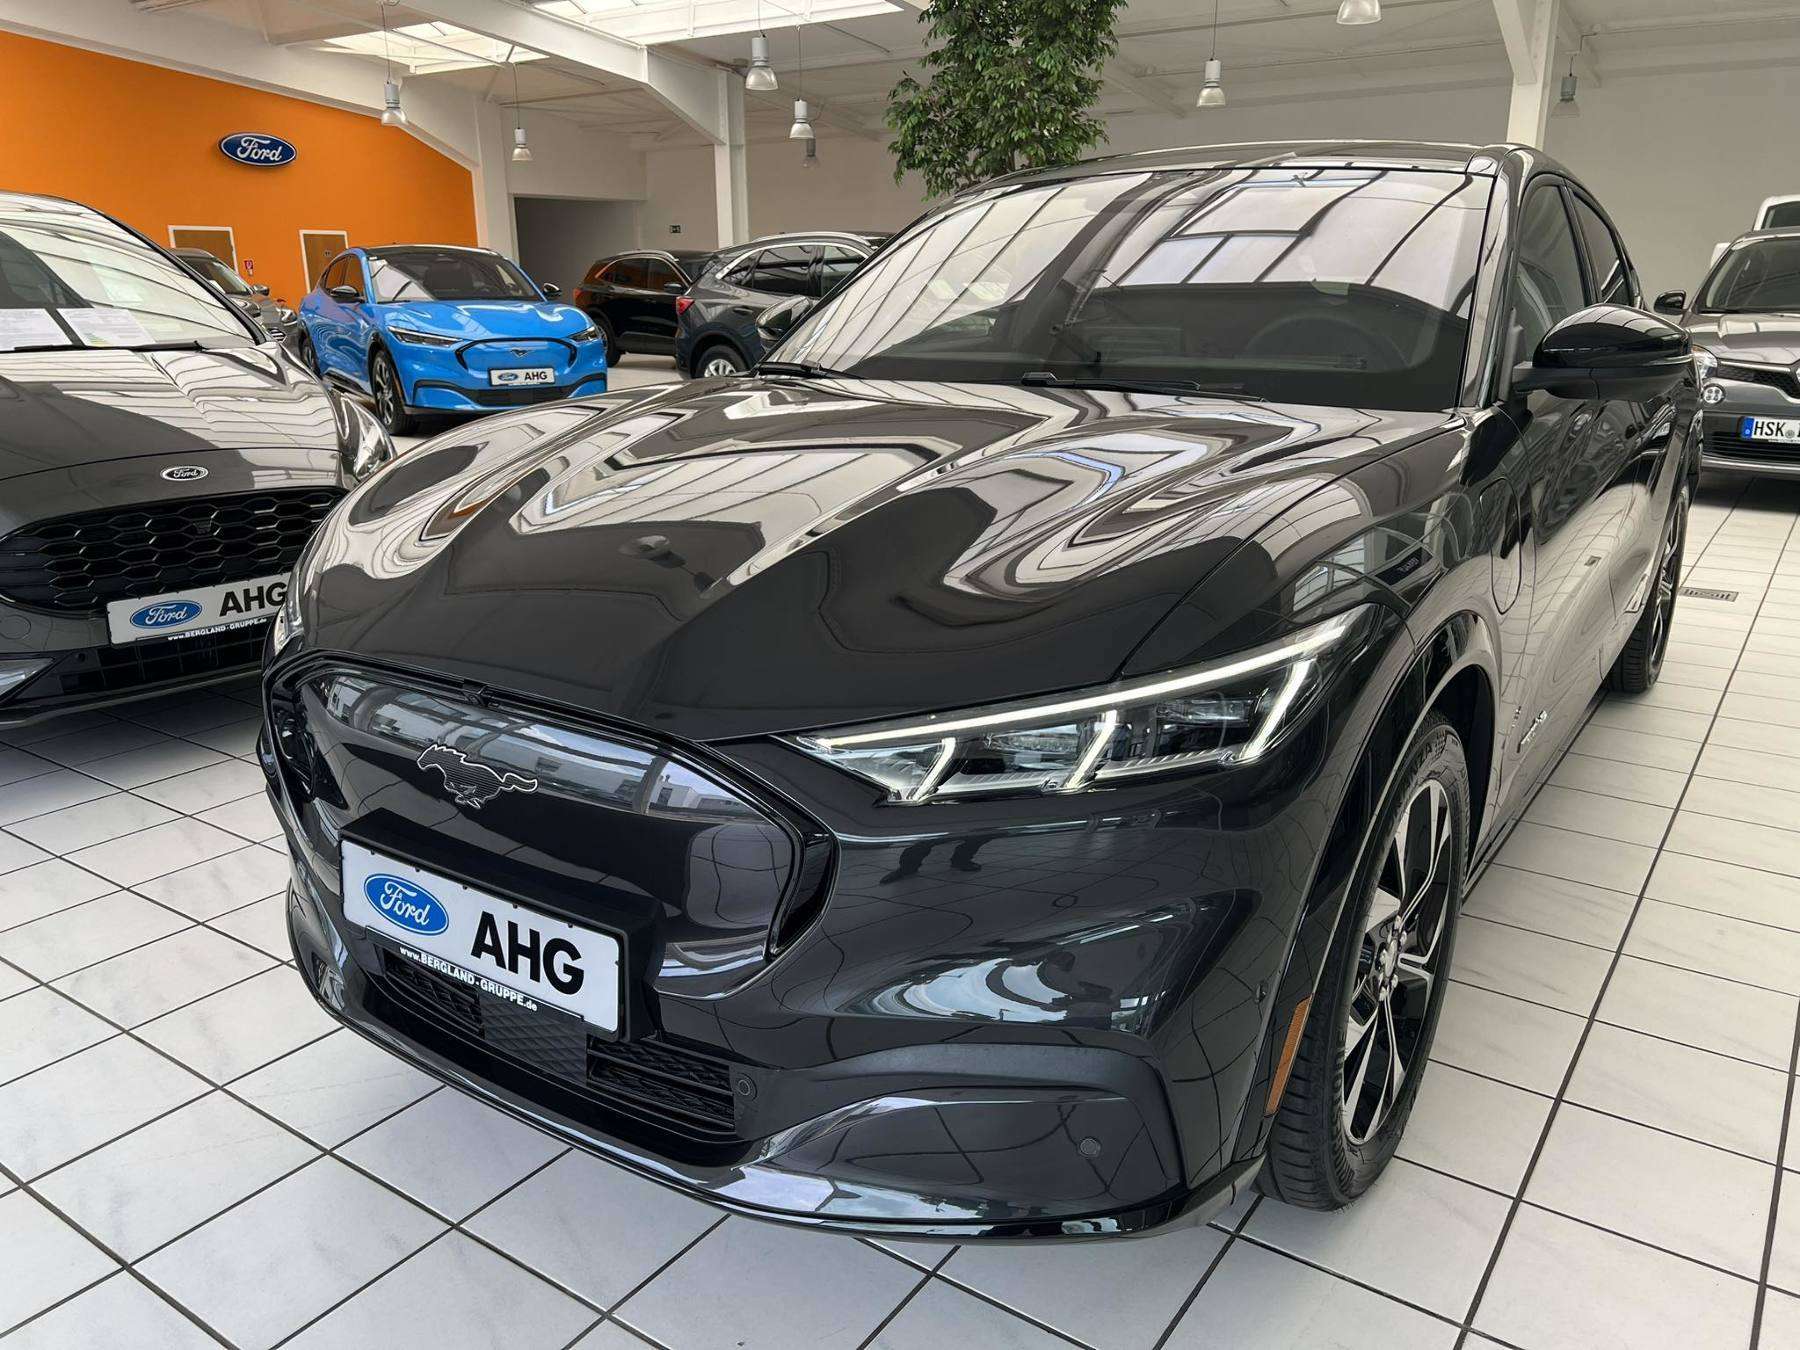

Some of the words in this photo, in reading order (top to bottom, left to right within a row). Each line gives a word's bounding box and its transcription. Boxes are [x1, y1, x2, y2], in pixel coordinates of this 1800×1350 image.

[237, 136, 282, 161] Ford
[524, 371, 548, 381] AHG
[1753, 420, 1786, 437] HSK
[173, 468, 199, 478] Ford
[145, 604, 187, 625] Ford
[219, 582, 288, 617] AHG
[380, 881, 430, 926] Ford
[470, 911, 585, 995] AHG
[400, 947, 538, 1012] www.BERGLAND-GRUPPE.de
